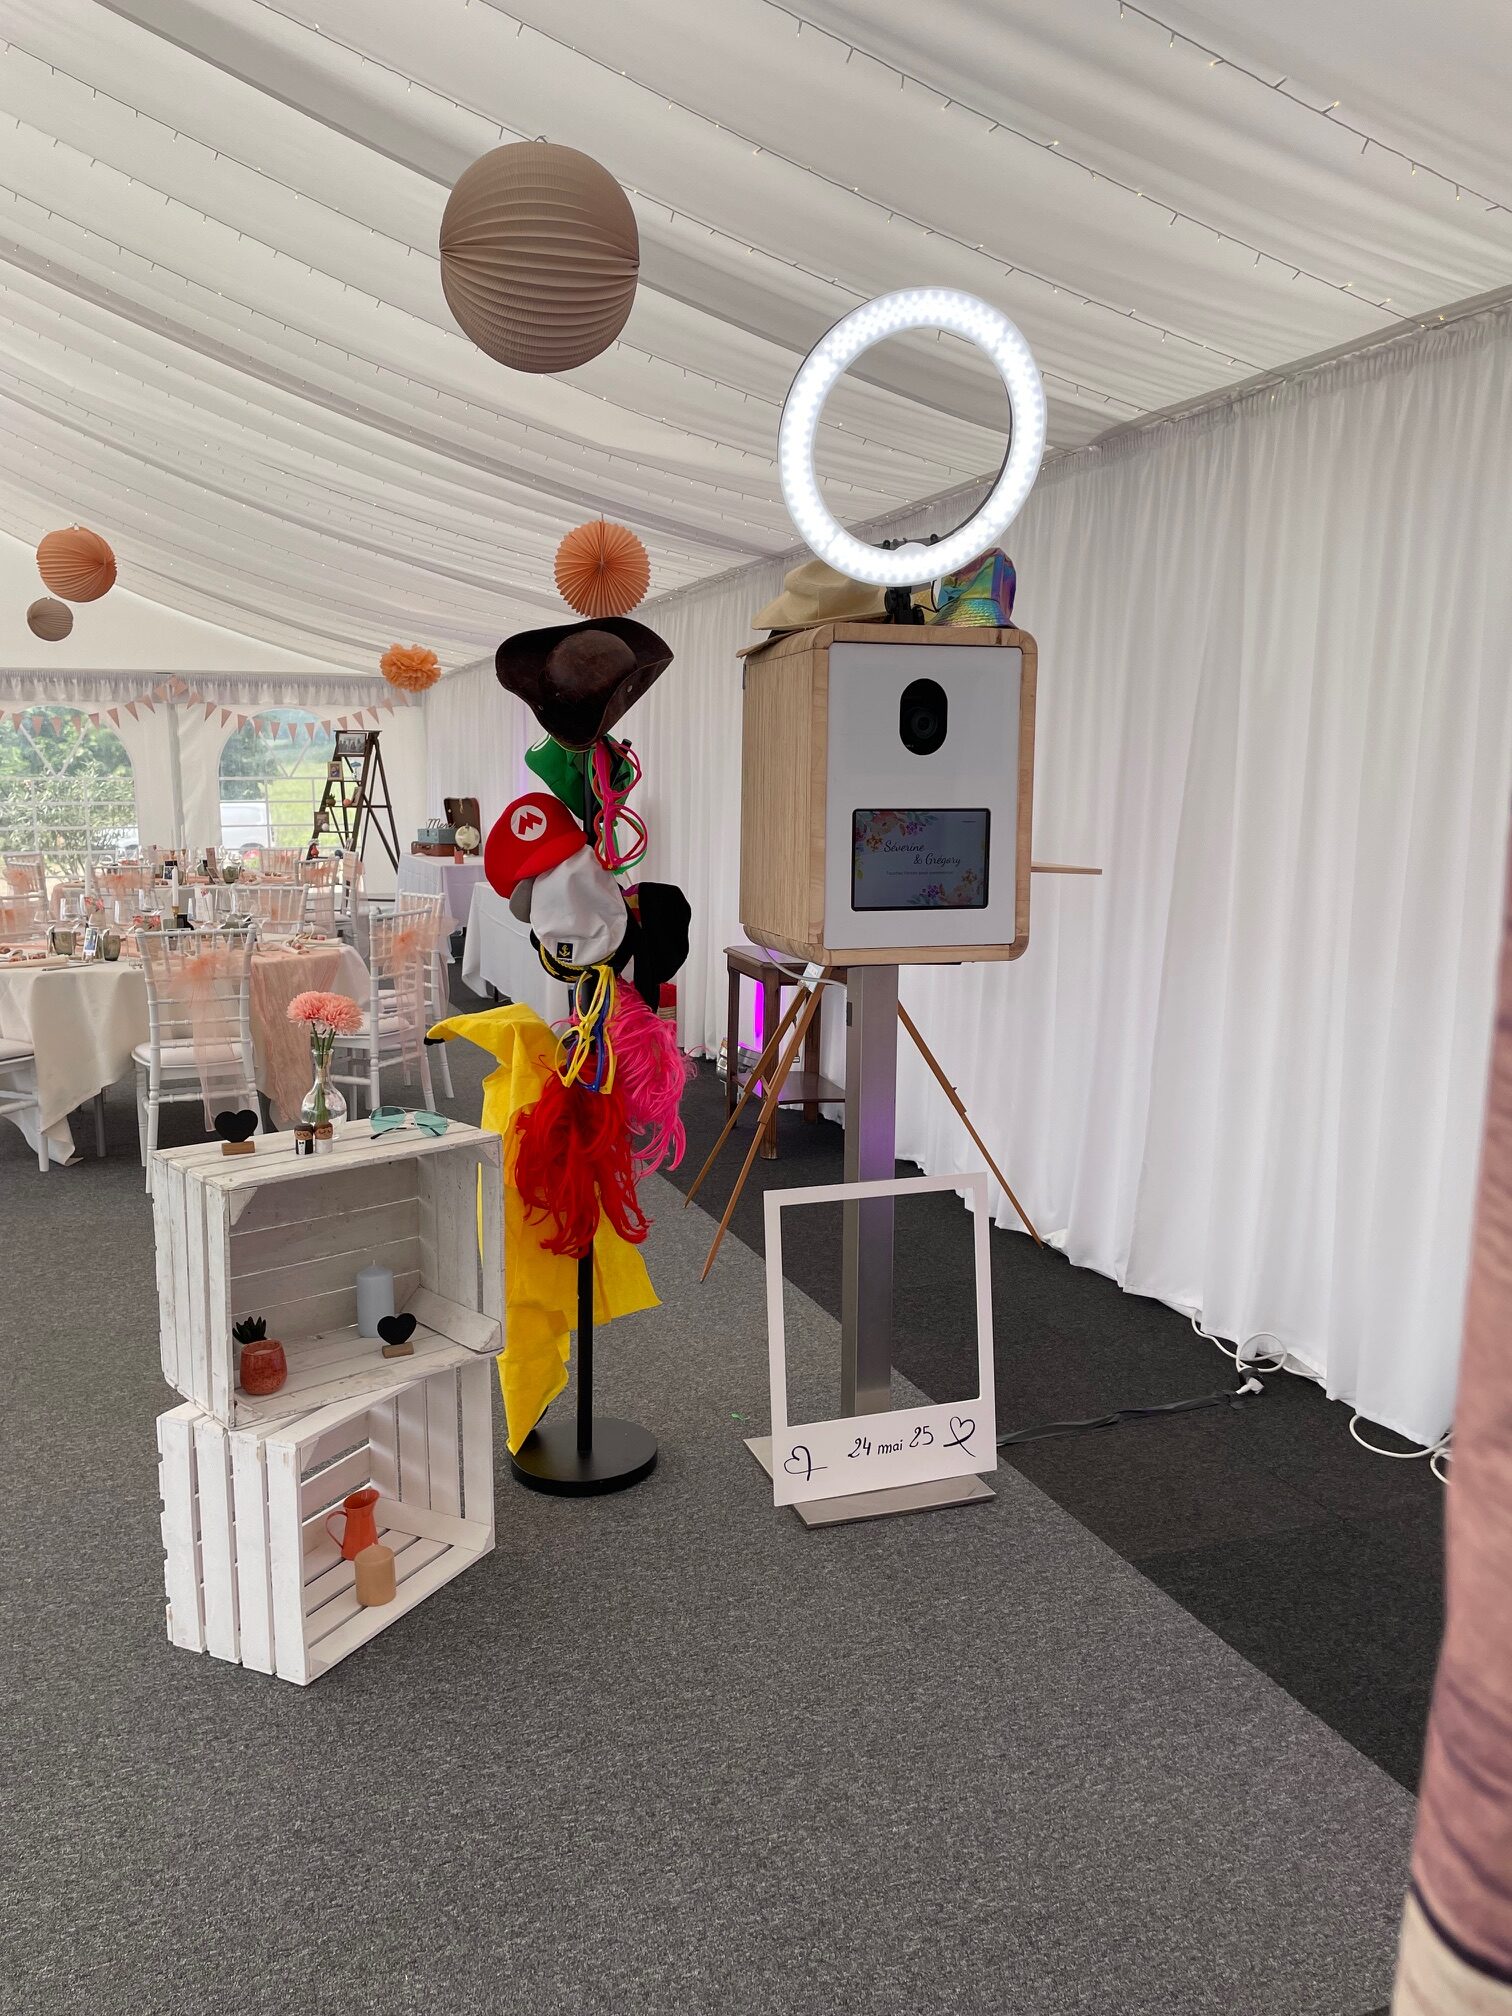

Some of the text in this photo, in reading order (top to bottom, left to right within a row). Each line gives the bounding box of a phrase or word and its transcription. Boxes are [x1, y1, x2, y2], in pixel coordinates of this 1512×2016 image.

[518, 812, 543, 835] M
[884, 841, 924, 853] Séverine
[913, 853, 961, 867] & Grégory
[848, 1426, 934, 1458] 24 mai 25
